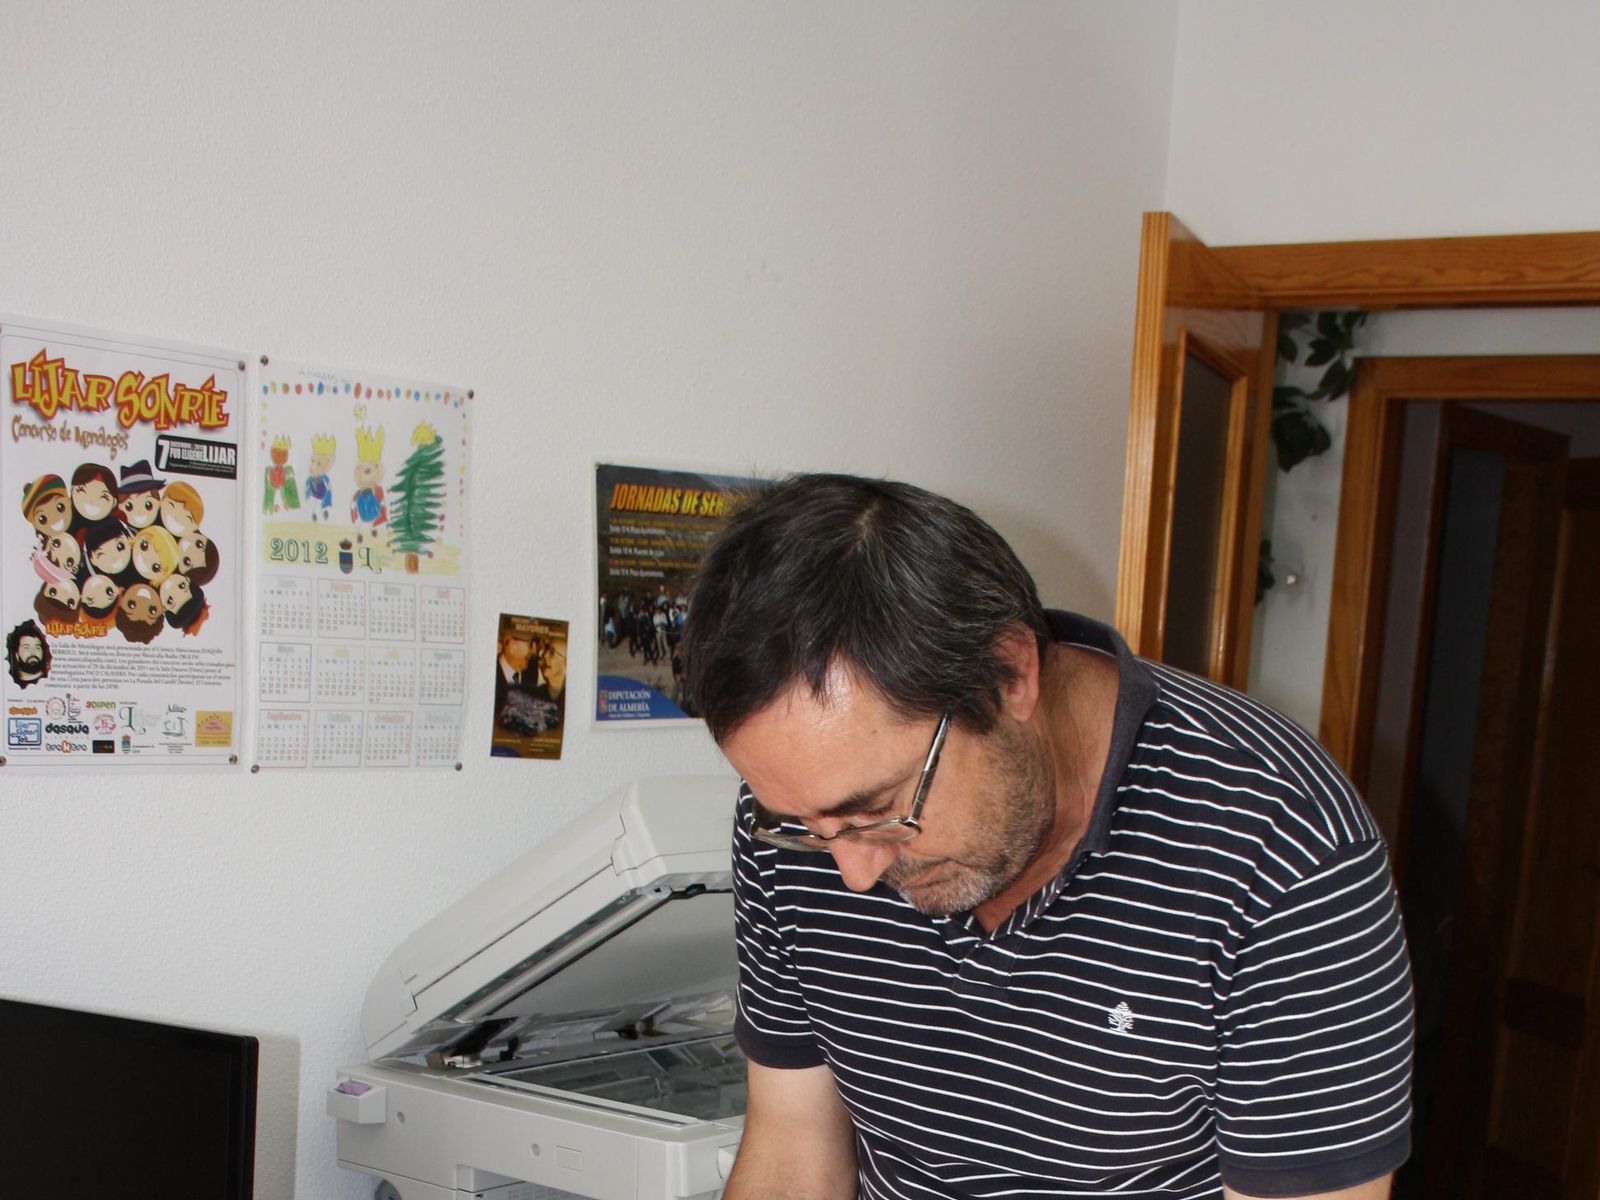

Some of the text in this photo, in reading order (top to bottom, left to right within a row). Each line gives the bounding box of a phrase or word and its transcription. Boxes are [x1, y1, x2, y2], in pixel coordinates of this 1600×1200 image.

[59, 420, 71, 441] de
[609, 482, 682, 514] JORNADAS
[682, 489, 701, 515] DE
[270, 537, 329, 564] 2012
[608, 701, 650, 712] DE ALMERÍA
